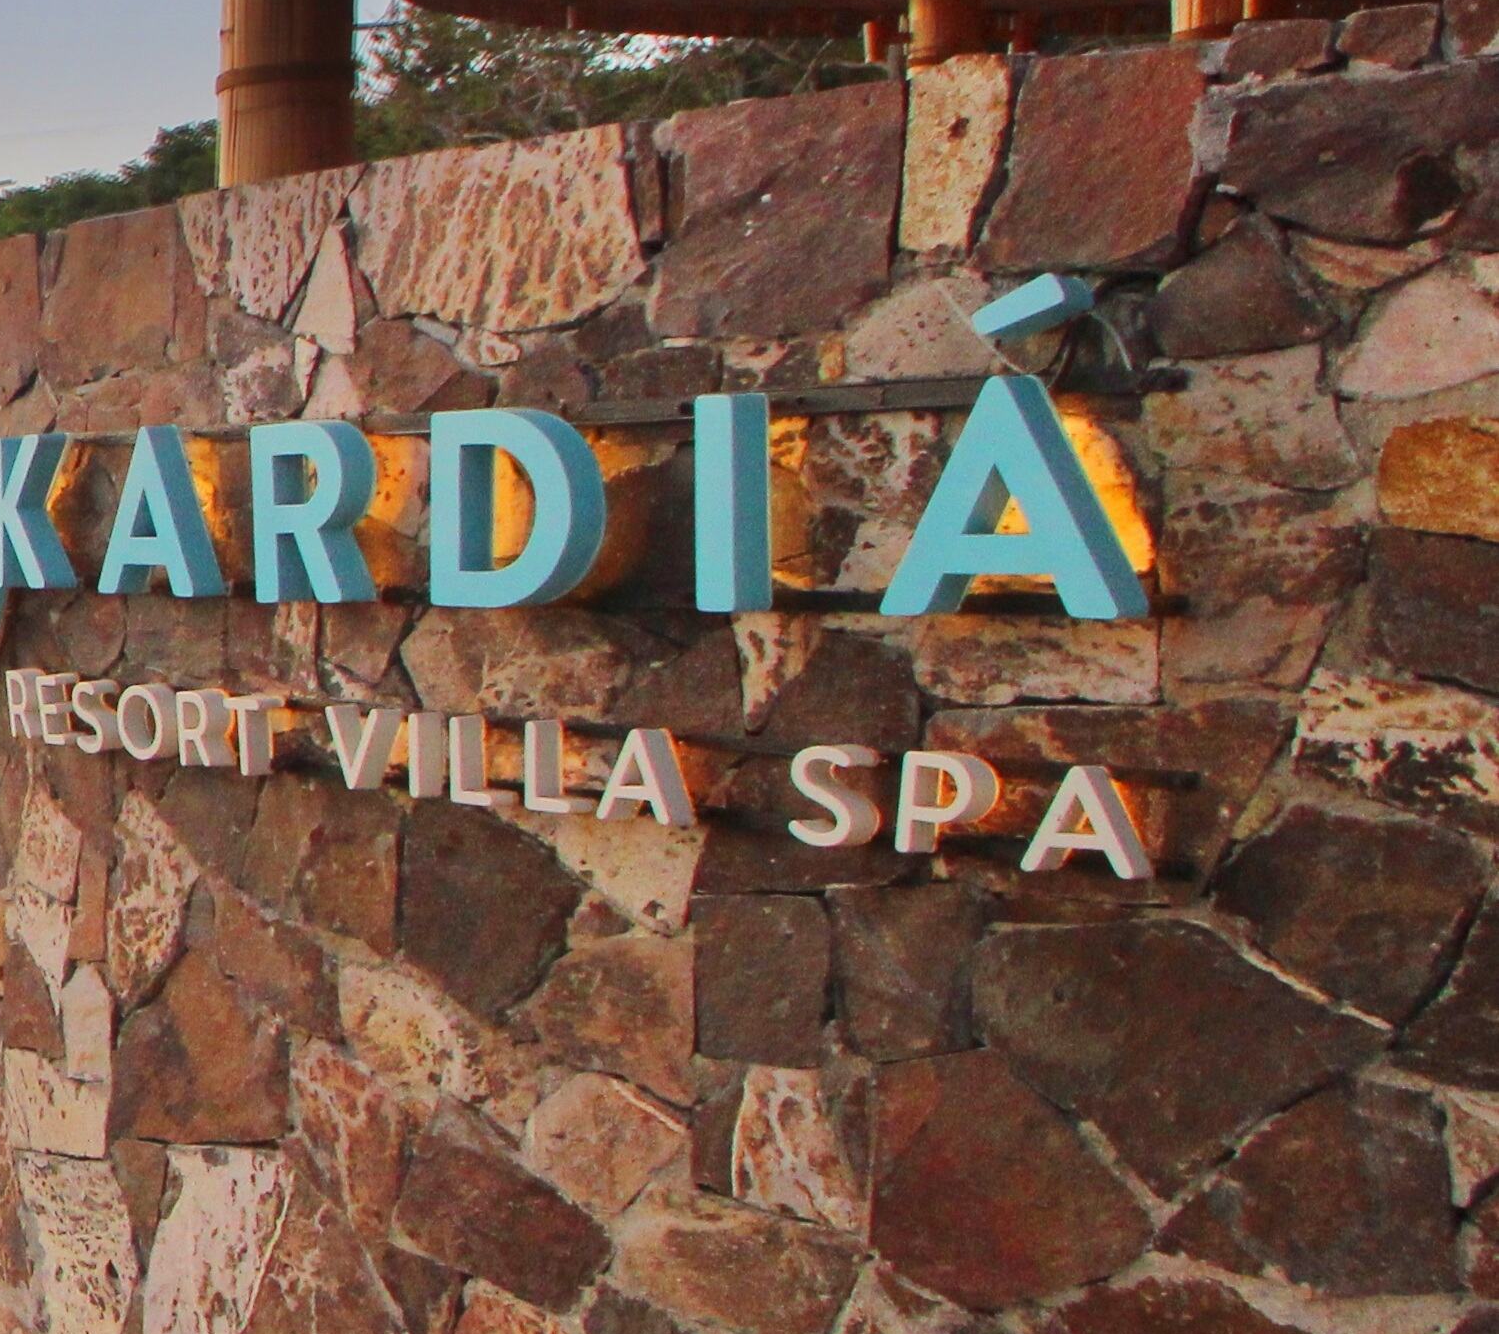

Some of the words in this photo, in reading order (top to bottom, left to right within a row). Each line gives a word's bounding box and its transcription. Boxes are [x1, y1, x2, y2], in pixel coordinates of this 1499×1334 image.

[5, 667, 286, 776] RESORT
[325, 703, 698, 827] VILLA
[788, 743, 1155, 881] SPA
